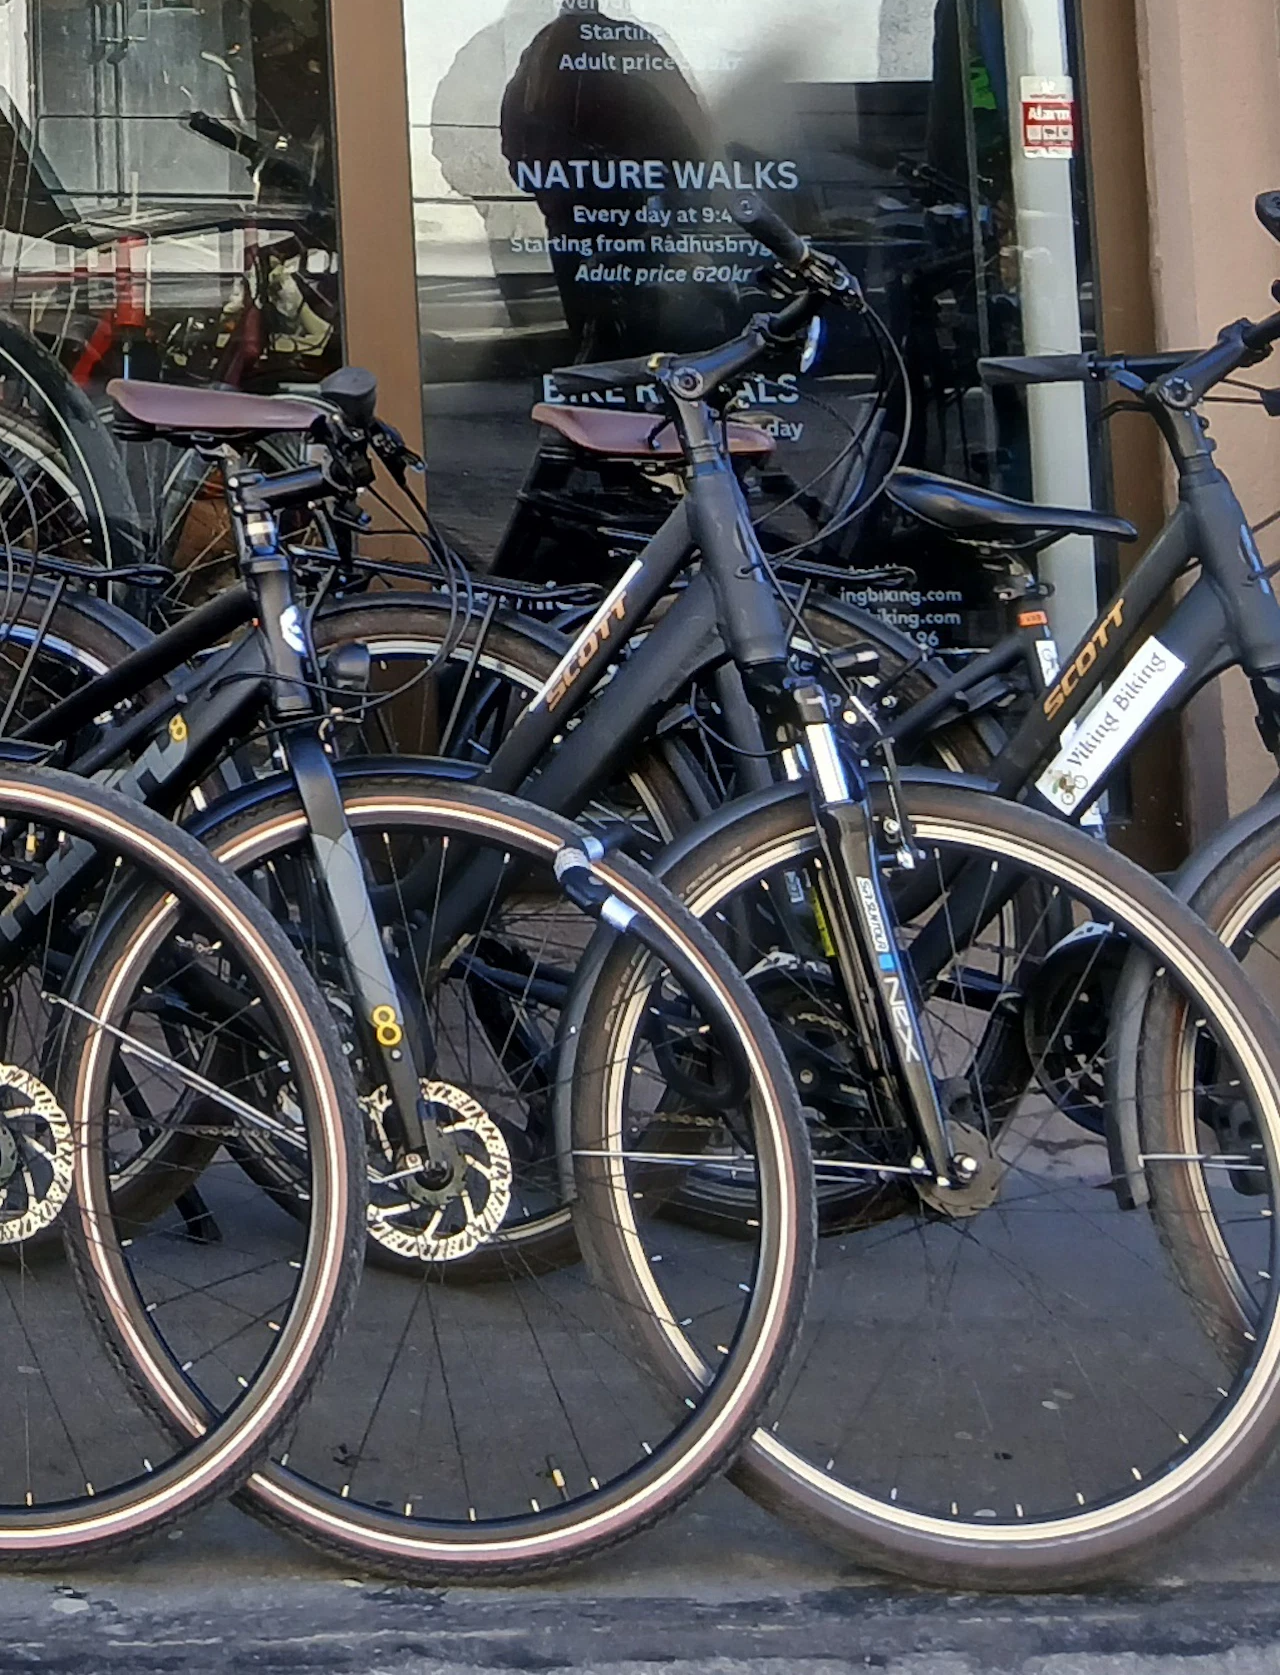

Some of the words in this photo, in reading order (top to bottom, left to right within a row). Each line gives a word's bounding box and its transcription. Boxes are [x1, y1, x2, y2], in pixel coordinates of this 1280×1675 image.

[559, 52, 617, 71] Adult
[622, 54, 676, 74] price
[1028, 106, 1071, 121] Alarm
[517, 160, 665, 190] NATURE
[672, 160, 799, 190] WALKS
[573, 205, 633, 227] Every
[635, 204, 671, 227] day
[677, 207, 696, 223] at
[701, 206, 743, 223] 9:4
[511, 237, 593, 256] Starting
[596, 236, 646, 253] from
[575, 265, 630, 282] Adult
[634, 267, 687, 286] price
[692, 265, 756, 283] 620kr
[546, 594, 628, 711] SCOTT
[1043, 598, 1125, 721] SCOTT
[1066, 709, 1121, 767] Viking
[1111, 651, 1168, 712] Biking
